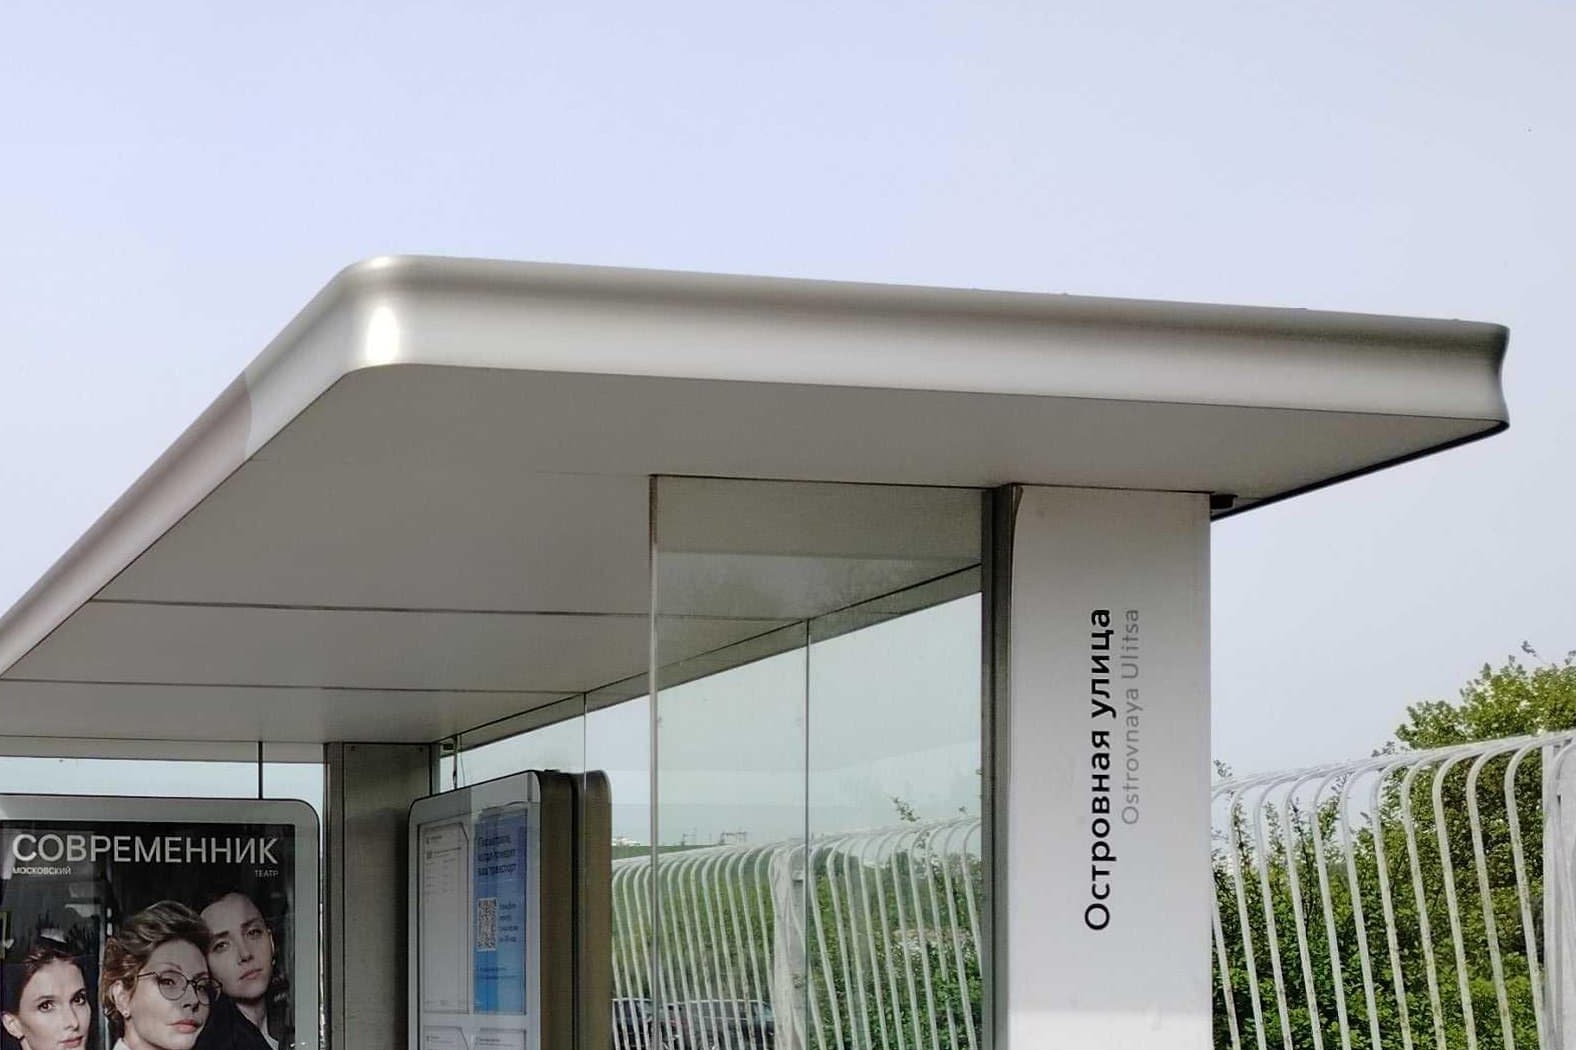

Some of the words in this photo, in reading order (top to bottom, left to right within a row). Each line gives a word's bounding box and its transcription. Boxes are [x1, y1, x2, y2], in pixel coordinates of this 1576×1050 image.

[1090, 608, 1116, 719] улица
[1119, 608, 1140, 681] Ulitsa
[1120, 687, 1144, 826] Ostrovnaya
[11, 833, 279, 865] СОВРЕМЕННИК
[1084, 729, 1116, 931] Островная
[12, 865, 72, 876] МОСКОВСКИЙ
[254, 869, 279, 879] ТЕАТР
